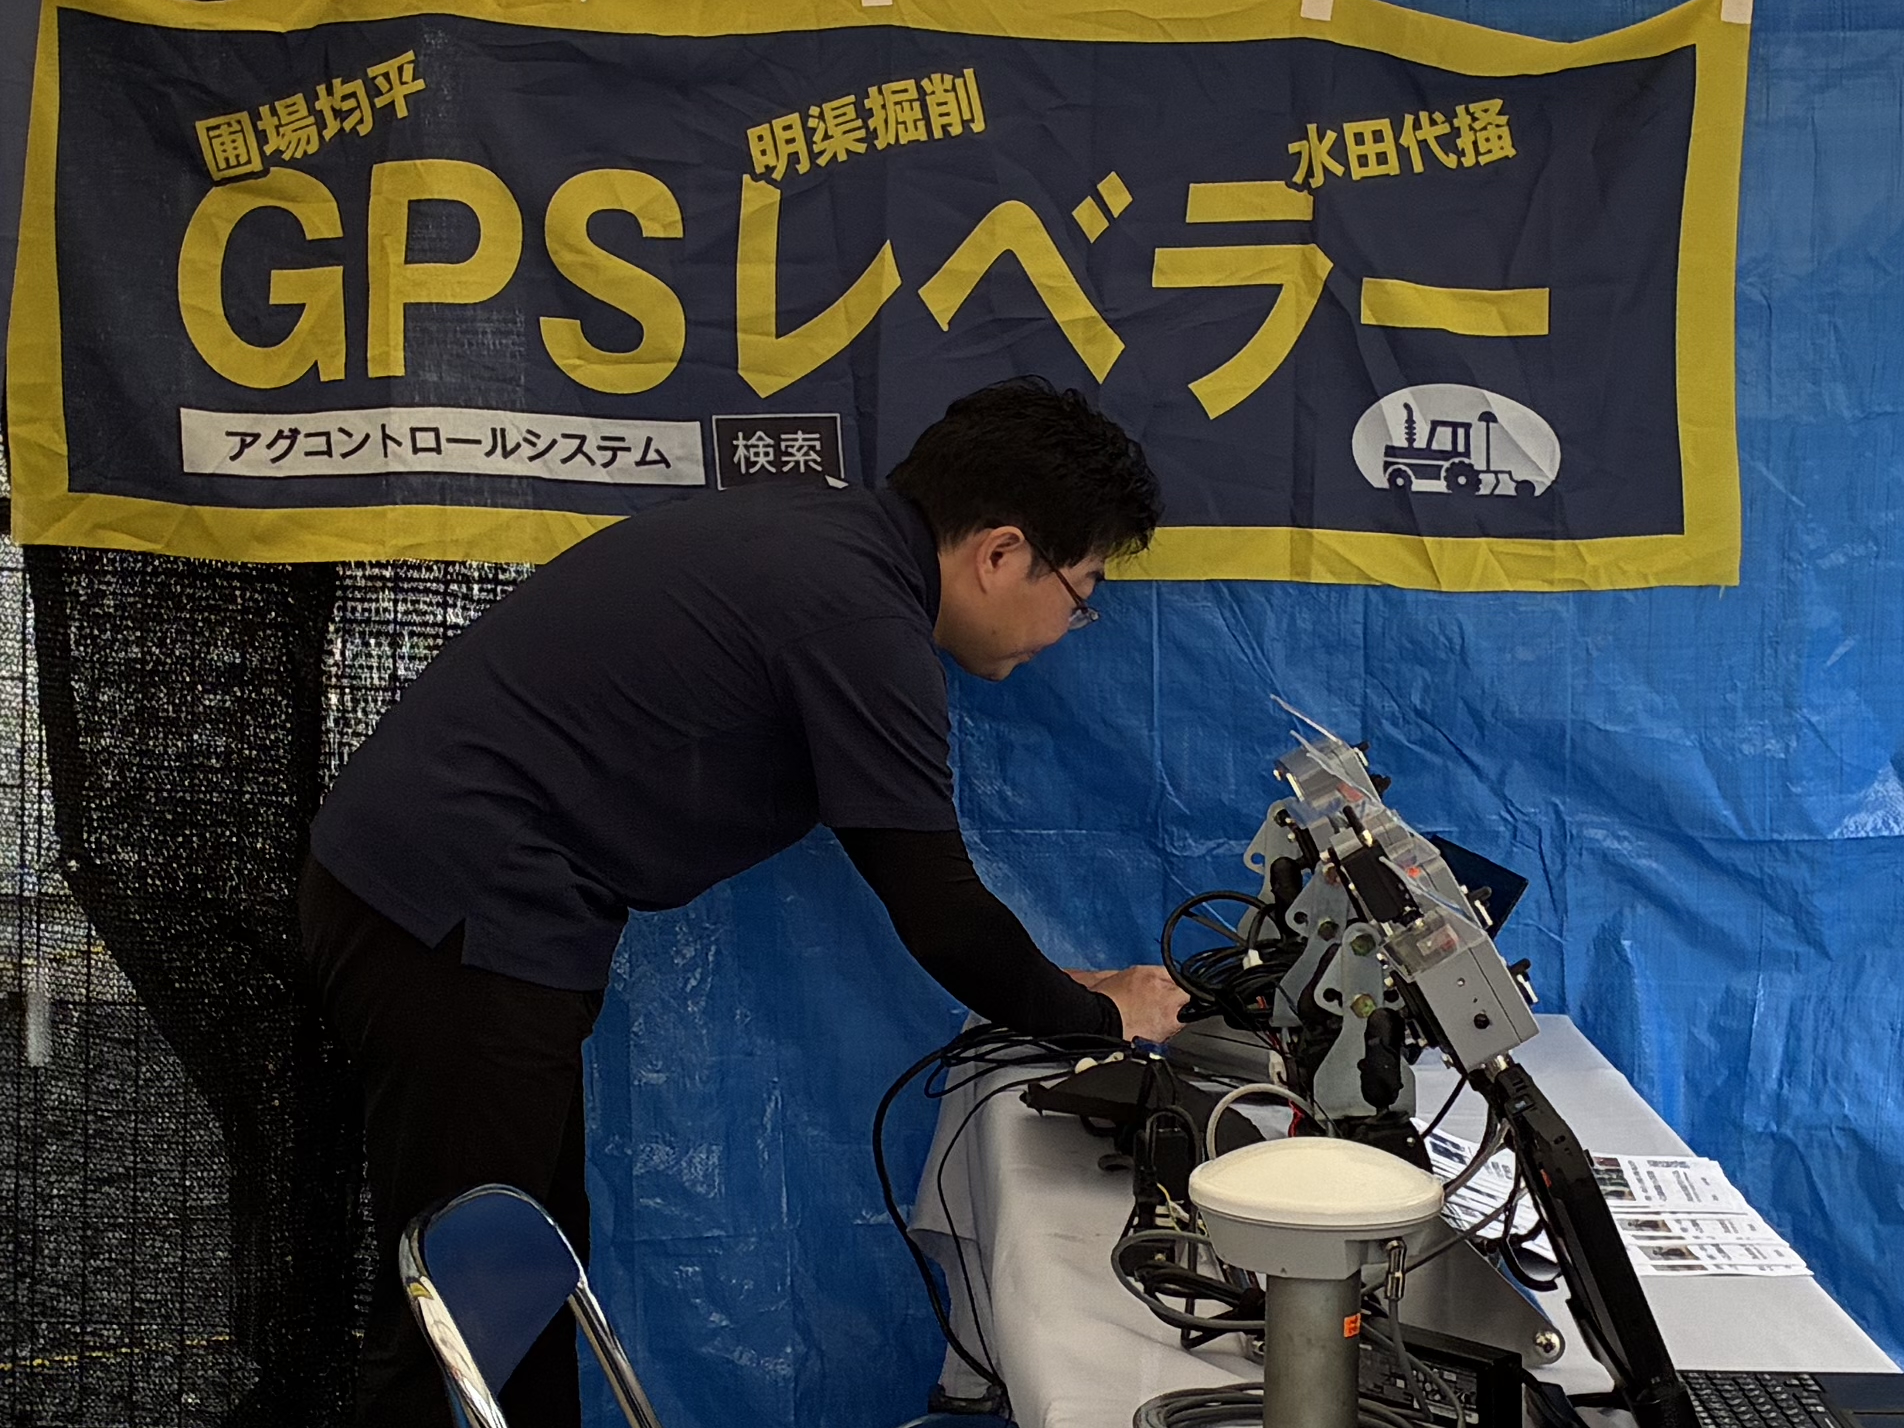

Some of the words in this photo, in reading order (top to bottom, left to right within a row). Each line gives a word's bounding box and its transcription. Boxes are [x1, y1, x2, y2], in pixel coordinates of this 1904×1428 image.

[195, 49, 427, 182] 圃場均平
[746, 67, 987, 183] 明渠掘削
[176, 158, 1550, 420] GPSレベラー
[225, 423, 673, 472] アグコントロールシステム
[731, 430, 824, 475] 検索
